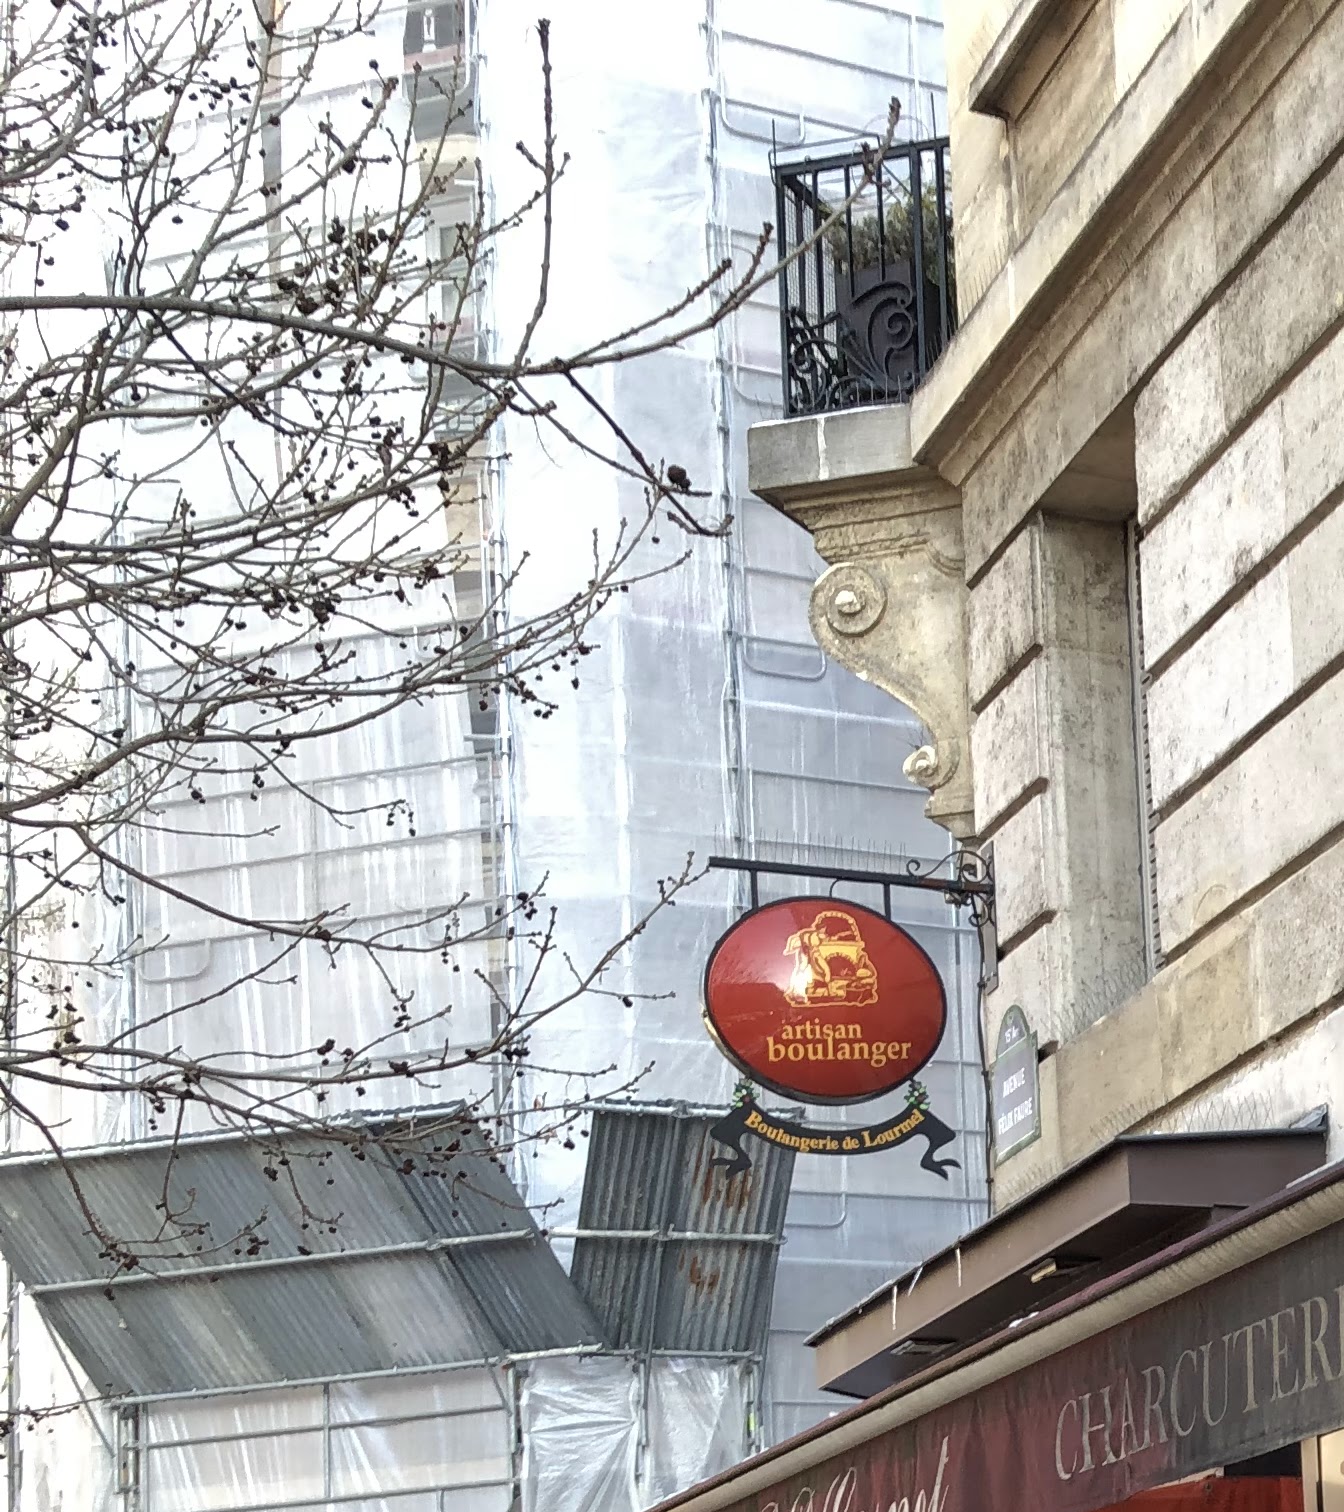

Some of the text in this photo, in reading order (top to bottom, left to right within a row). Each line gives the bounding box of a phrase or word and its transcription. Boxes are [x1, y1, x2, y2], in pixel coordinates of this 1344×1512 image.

[781, 1018, 862, 1040] artisan
[766, 1036, 912, 1068] boulanger
[744, 1108, 925, 1152] Boulangerie de Lourmel
